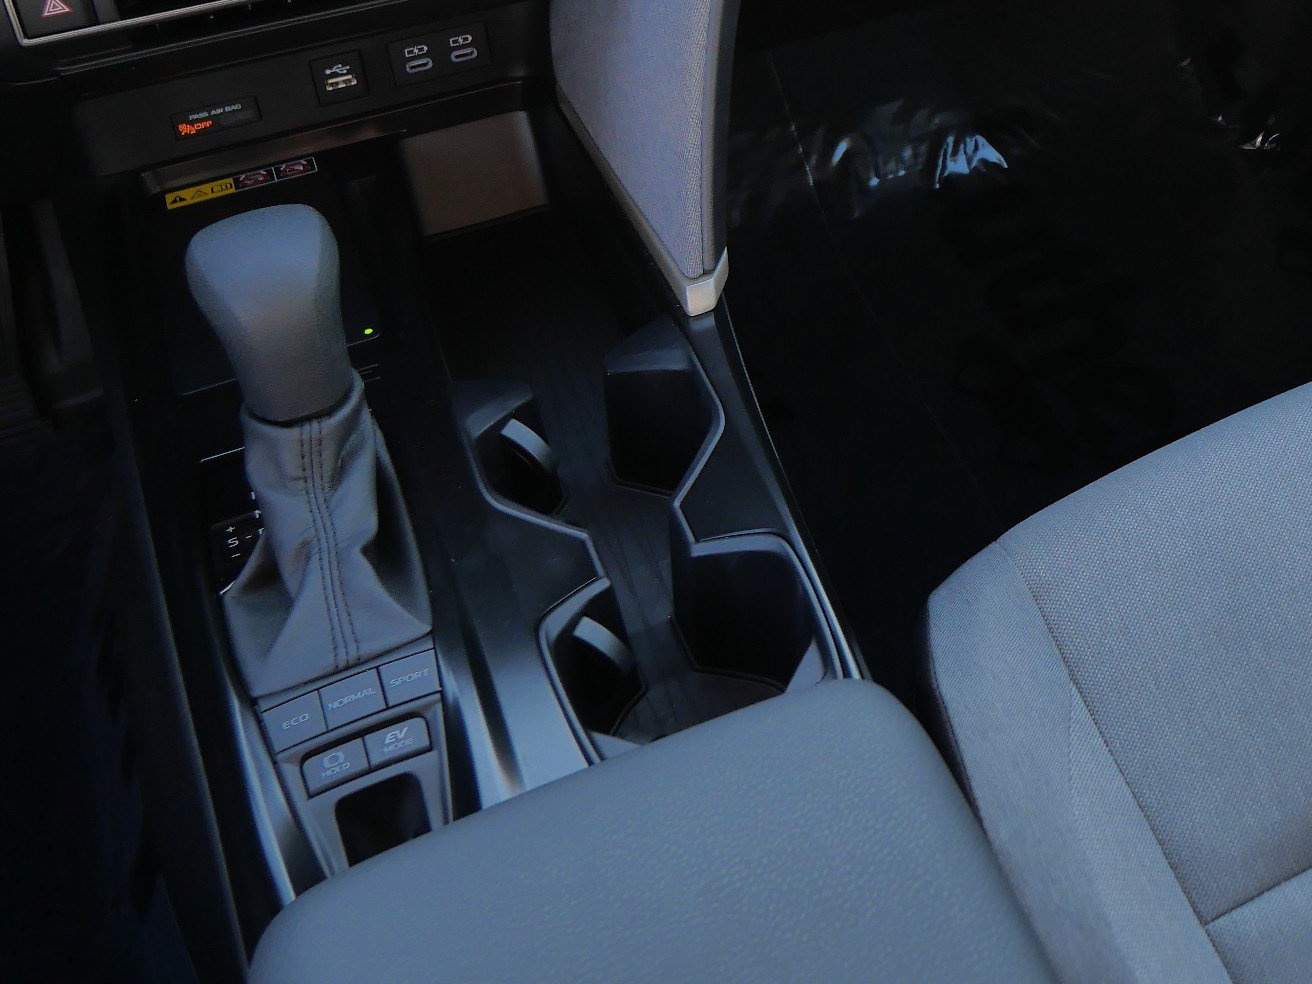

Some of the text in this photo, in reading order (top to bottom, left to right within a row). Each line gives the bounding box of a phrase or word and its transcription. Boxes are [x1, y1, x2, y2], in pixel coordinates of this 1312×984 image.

[390, 668, 430, 688] SPORT
[327, 687, 376, 711] NORMAL
[282, 712, 309, 730] ECO
[384, 725, 409, 745] EV
[383, 737, 415, 754] MODE
